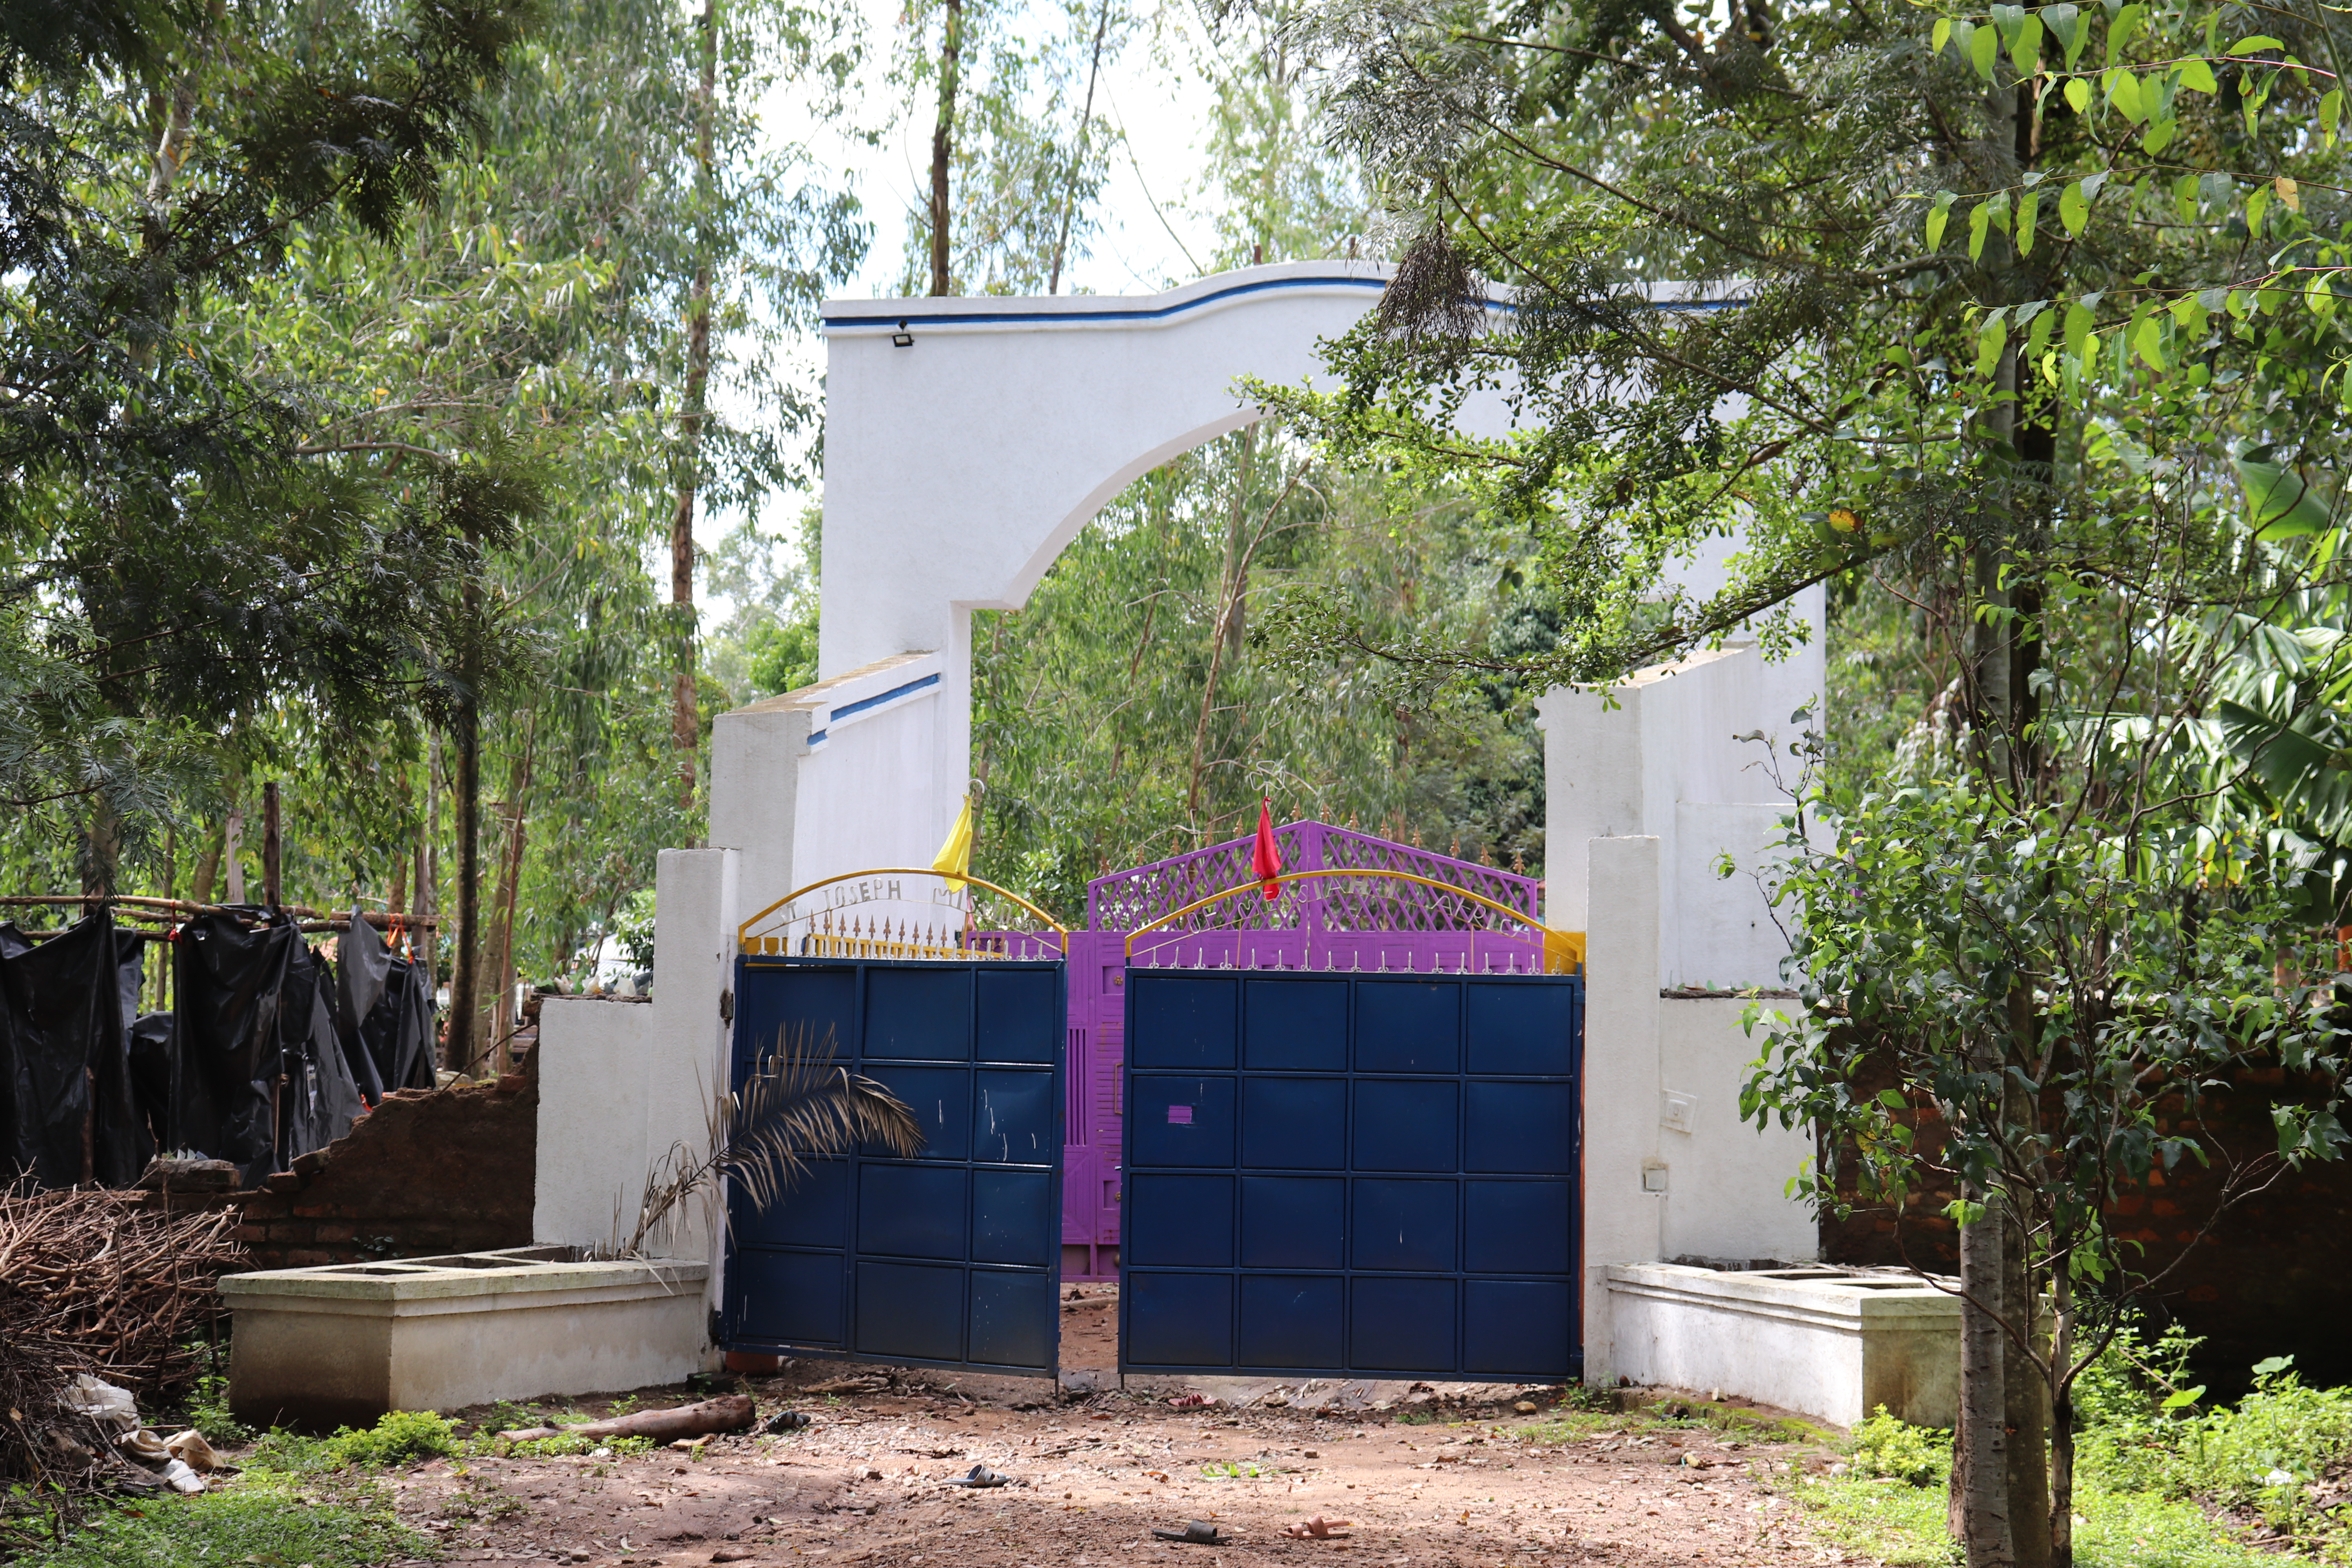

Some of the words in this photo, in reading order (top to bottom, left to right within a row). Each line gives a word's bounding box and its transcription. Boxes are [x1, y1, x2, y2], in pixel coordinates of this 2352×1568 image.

[778, 900, 797, 926] ST
[821, 877, 901, 911] JOSEPH
[1187, 903, 1217, 934] OF
[1238, 875, 1369, 920] MESSIAH
[1431, 895, 1530, 943] AFRICA
